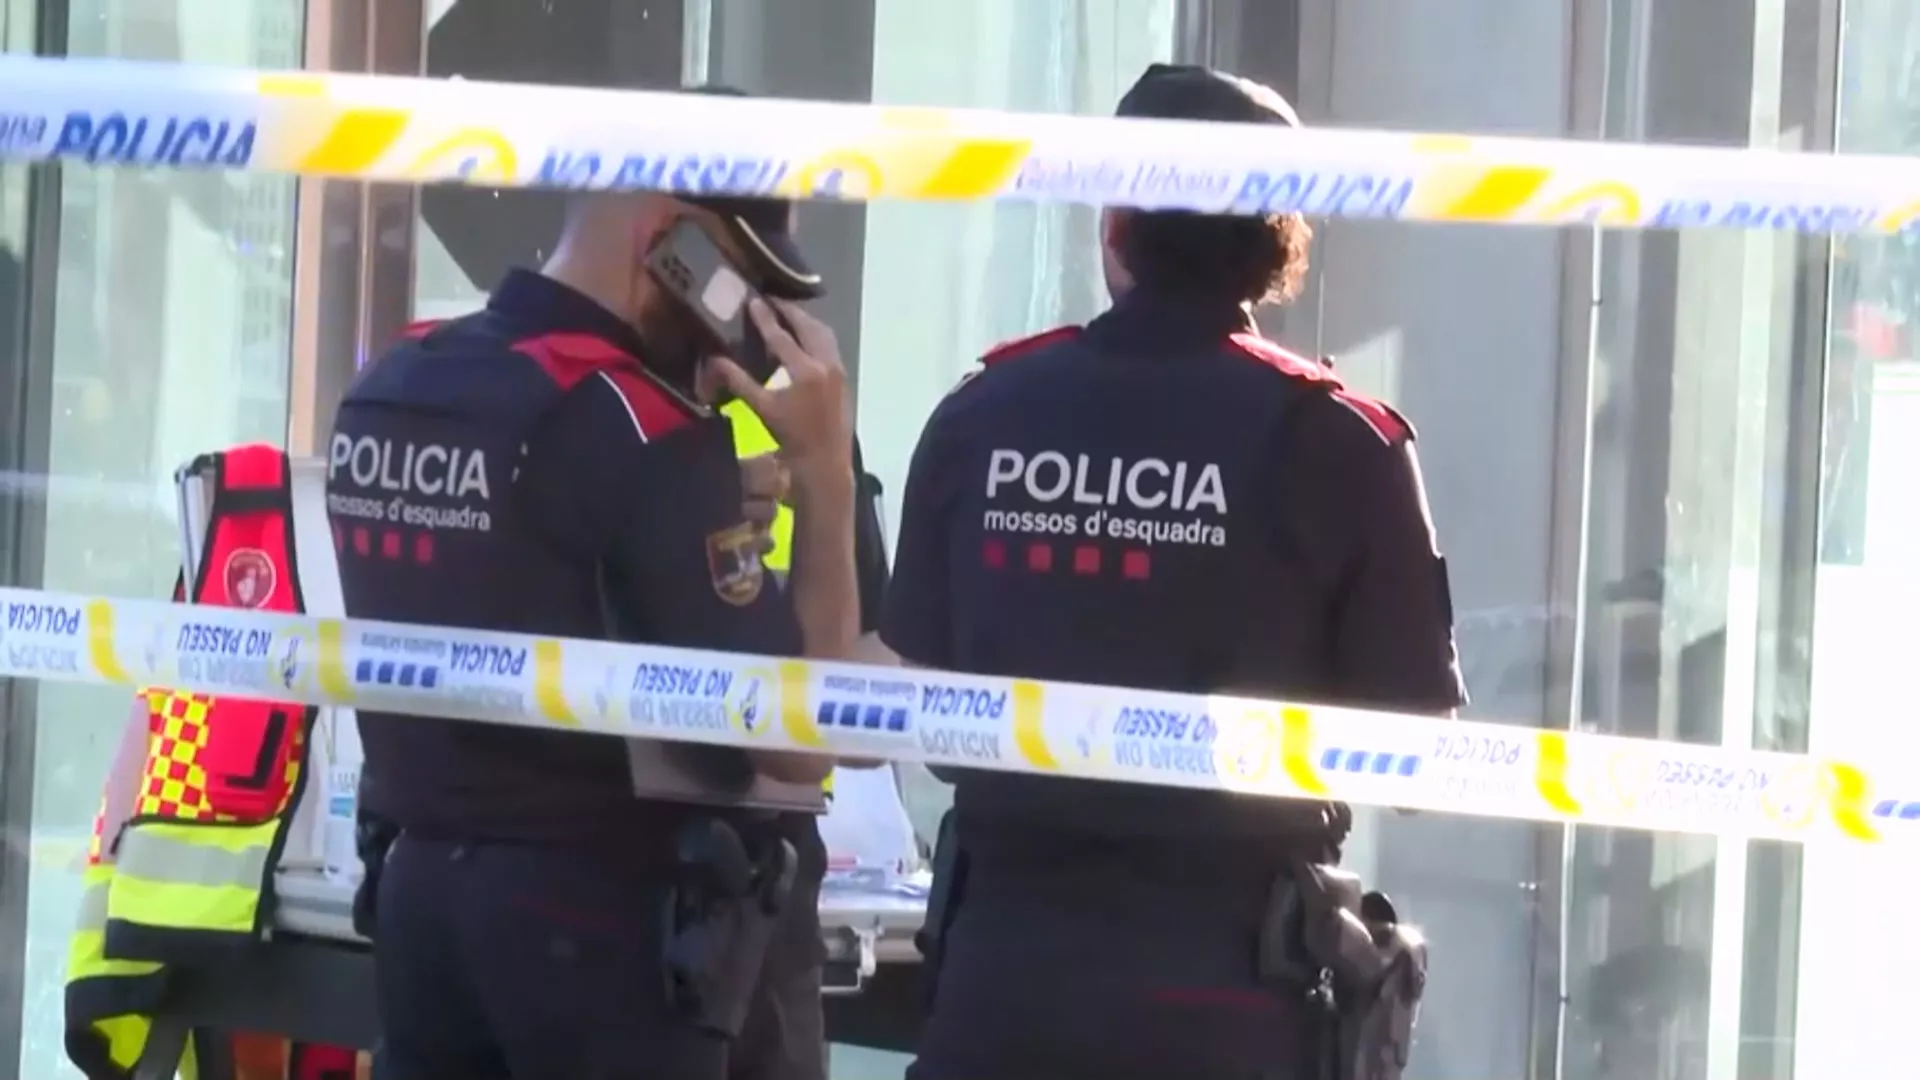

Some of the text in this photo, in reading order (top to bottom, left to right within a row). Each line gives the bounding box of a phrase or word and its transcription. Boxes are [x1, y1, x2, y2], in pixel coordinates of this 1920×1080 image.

[52, 110, 258, 168] POLICIA
[1234, 169, 1415, 217] POLICIA
[329, 432, 490, 499] POLICIA
[986, 449, 1228, 514] POLICIA
[387, 497, 490, 532] d'esquadra
[984, 510, 1226, 547] mossos d'esquadra
[8, 601, 81, 635] POLICIA
[177, 623, 272, 656] NO PASSEU
[451, 641, 527, 676] POLICIA
[632, 663, 733, 698] NO PASSEU
[920, 683, 1007, 719] POLICIA
[1113, 706, 1191, 742] PASSEU
